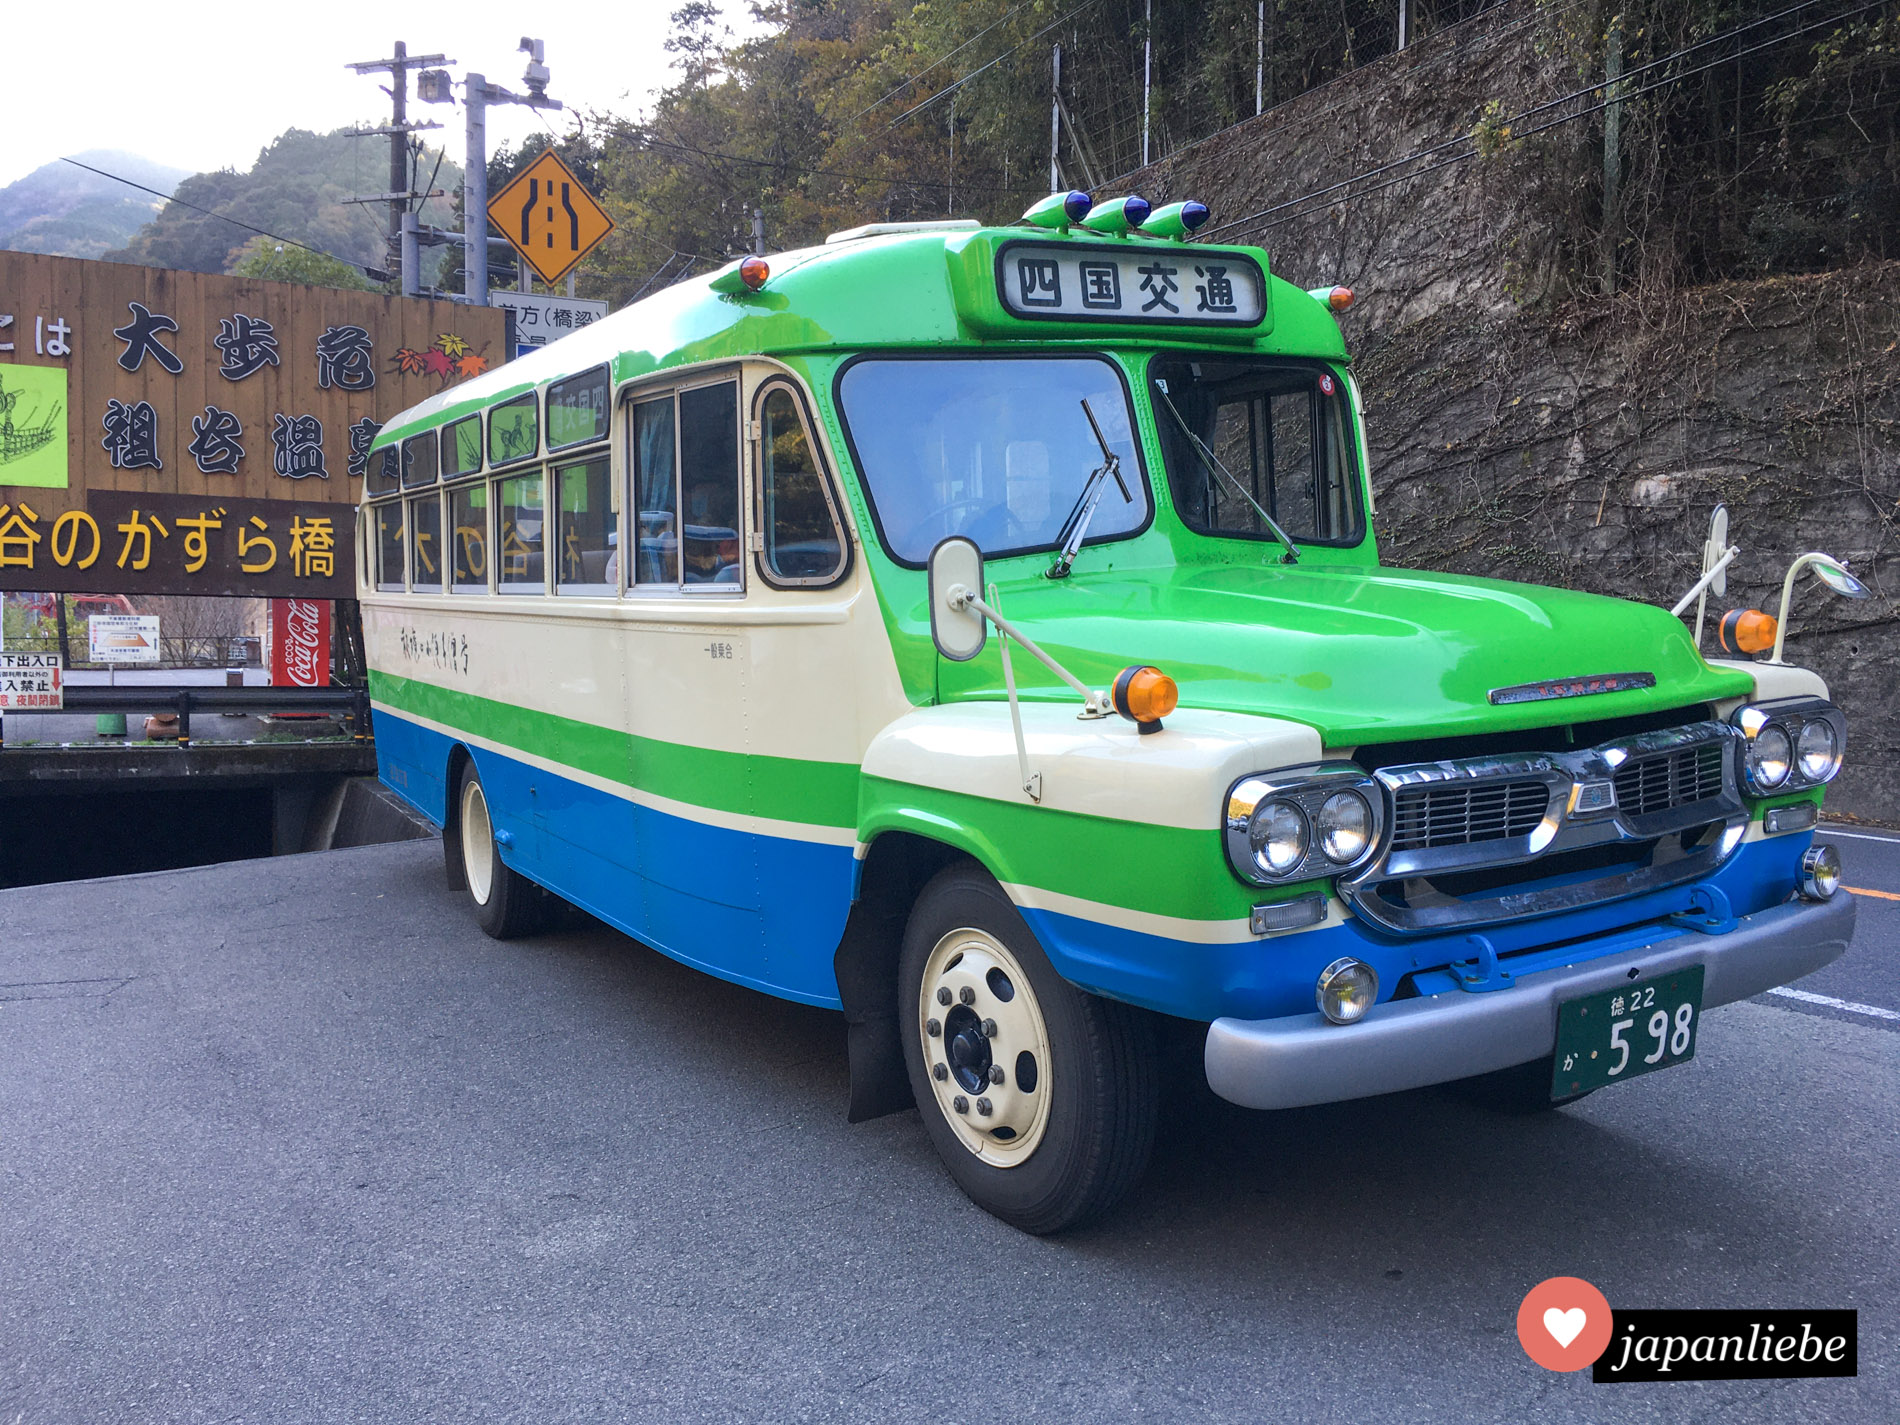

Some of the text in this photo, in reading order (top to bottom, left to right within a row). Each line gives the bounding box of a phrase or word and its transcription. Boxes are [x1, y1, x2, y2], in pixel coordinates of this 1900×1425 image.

[1017, 258, 1238, 314] 四国交通
[498, 303, 602, 329] 方(橋梁
[113, 301, 376, 390] 大歩危
[0, 501, 335, 578] 谷のかずら橋
[287, 599, 319, 687] Coca-Cola
[703, 642, 733, 660] 一般乗合
[0, 655, 58, 667] 下出入口
[0, 680, 50, 692] 入禁止
[16, 694, 60, 707] 夜間閉鎖
